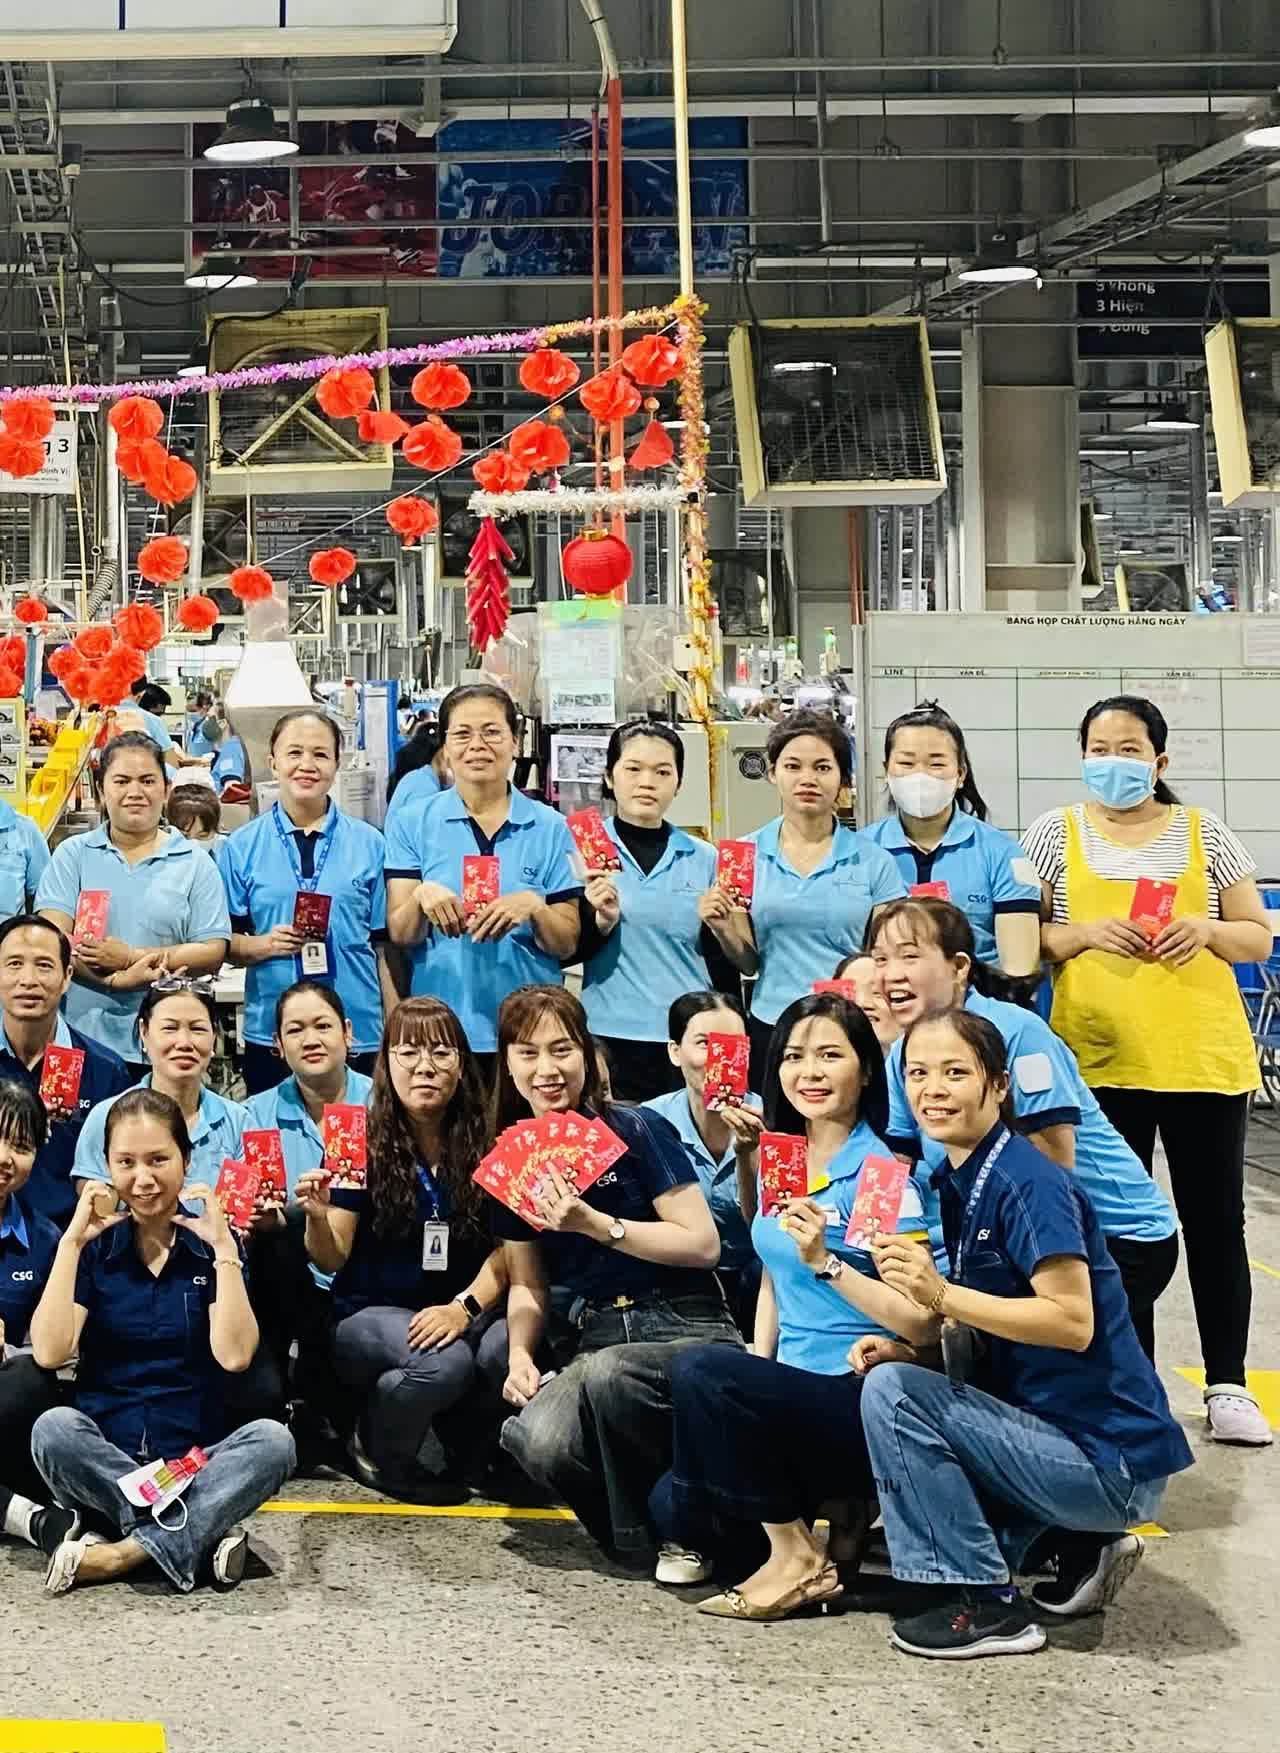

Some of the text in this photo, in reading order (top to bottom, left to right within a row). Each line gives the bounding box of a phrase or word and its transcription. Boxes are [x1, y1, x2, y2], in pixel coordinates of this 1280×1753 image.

[1096, 299, 1106, 312] 3
[58, 438, 69, 453] 3
[884, 668, 905, 676] LINE
[79, 1098, 91, 1109] SG
[596, 1171, 617, 1188] CSG
[11, 1270, 34, 1281] CSG
[192, 1275, 208, 1286] CS
